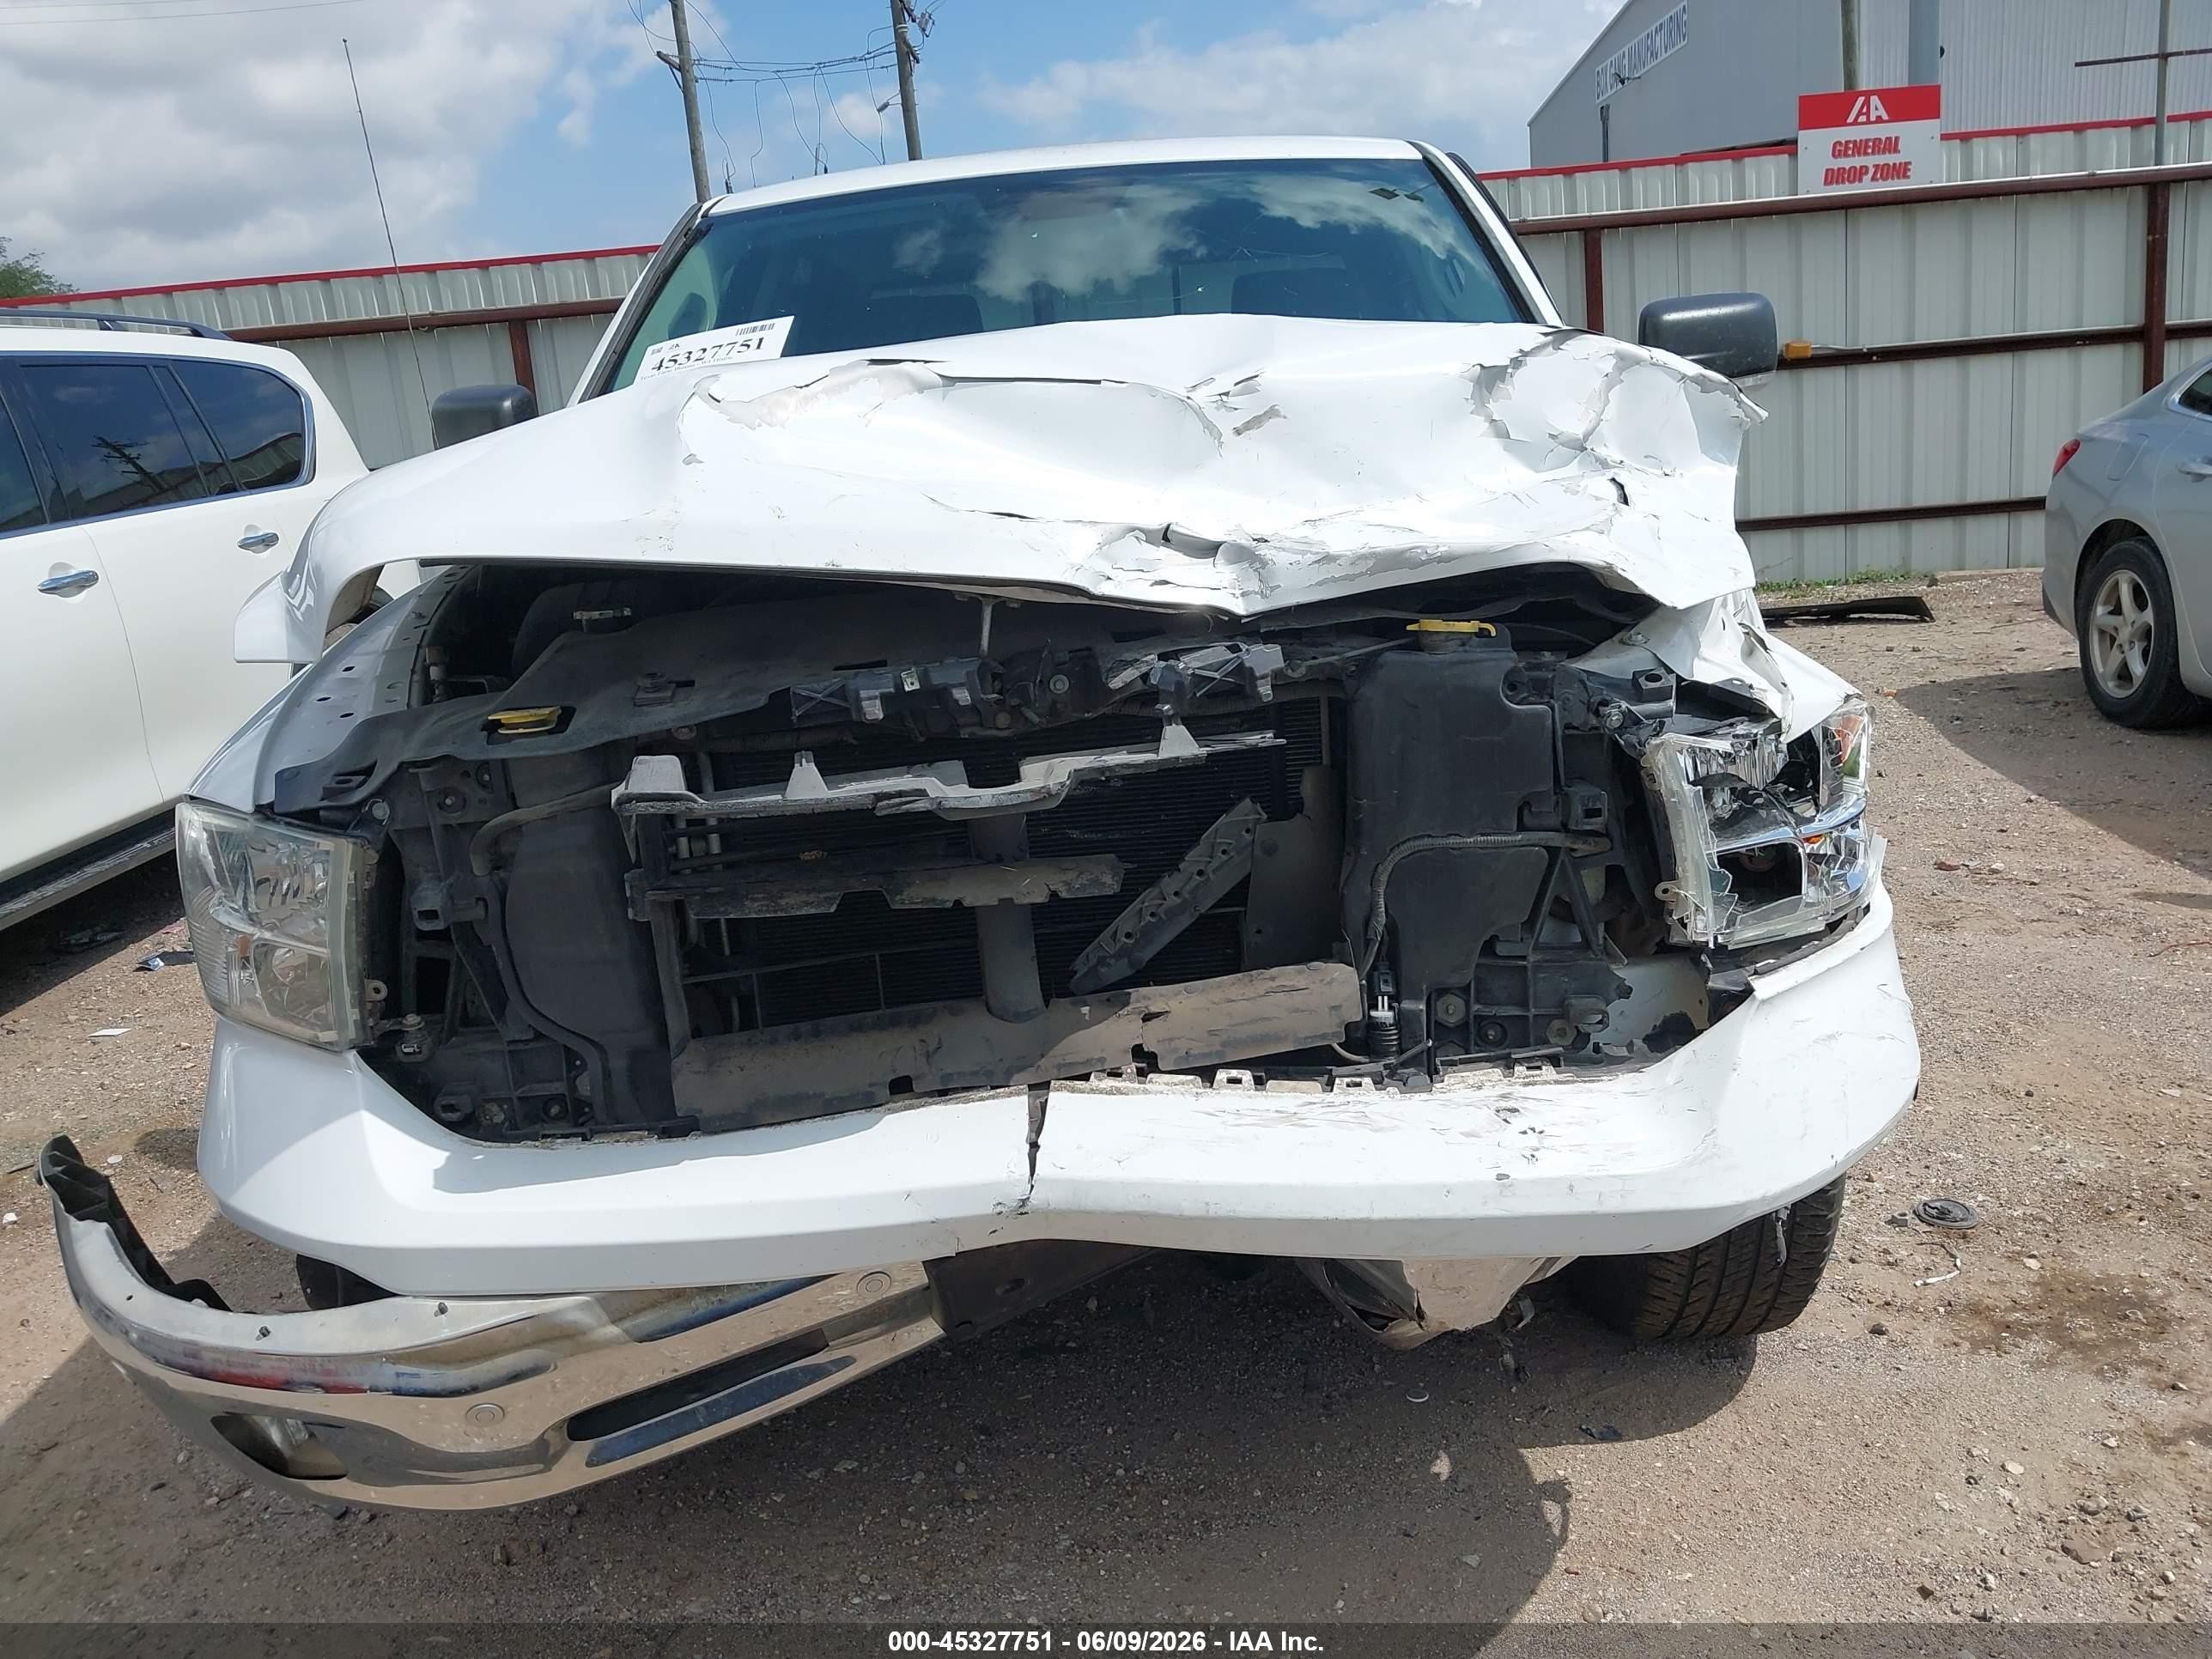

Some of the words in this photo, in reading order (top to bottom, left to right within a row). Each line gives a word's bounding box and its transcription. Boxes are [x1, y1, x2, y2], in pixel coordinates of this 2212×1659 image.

[1627, 3, 1687, 77] MANUFACTURING
[1831, 135, 1901, 160] GENERAL
[1823, 164, 1870, 187] DROP
[1870, 161, 1912, 183] ZONE
[651, 336, 765, 372] 45327751
